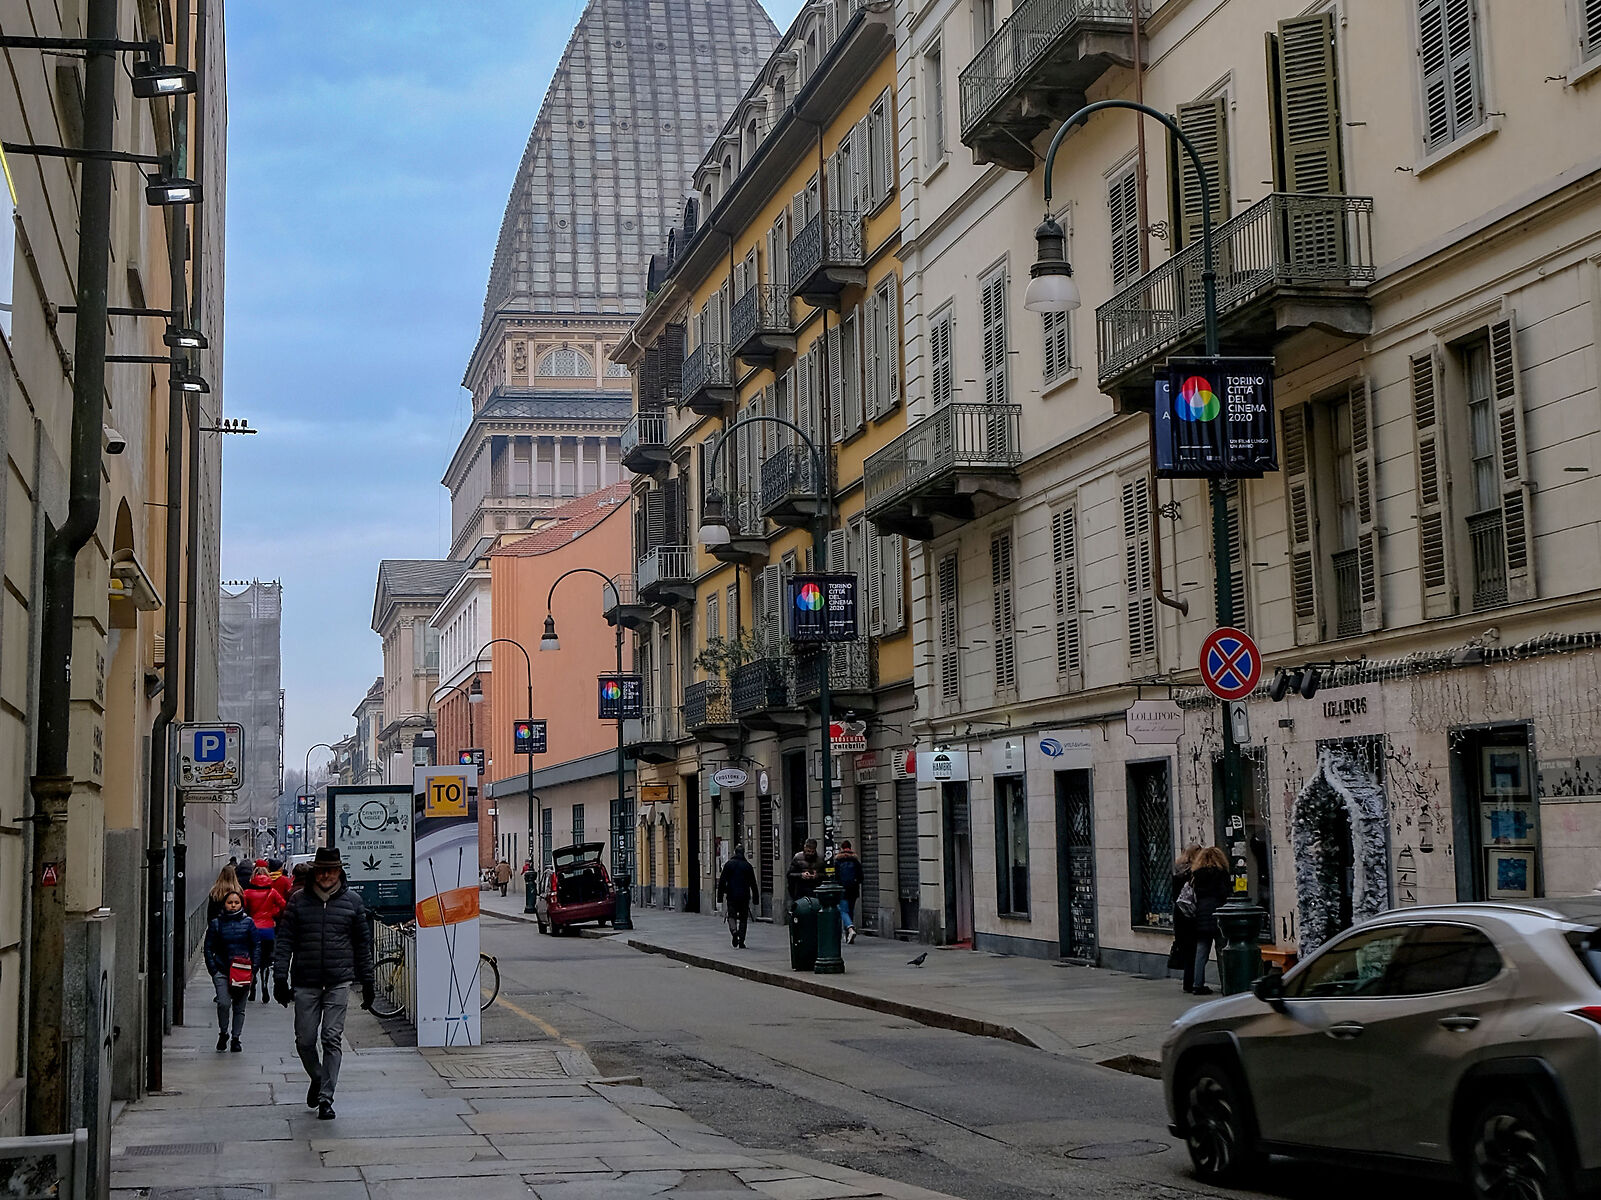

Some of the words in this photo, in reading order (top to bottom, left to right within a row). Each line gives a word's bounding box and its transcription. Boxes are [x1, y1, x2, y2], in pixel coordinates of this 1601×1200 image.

[1227, 377, 1264, 386] TORINO
[1228, 395, 1246, 404] DEL
[1228, 404, 1267, 413] CINEMA
[1228, 413, 1253, 422] 2020
[1131, 711, 1181, 720] LOLLIPOPS
[202, 736, 219, 758] P
[433, 784, 460, 802] TO
